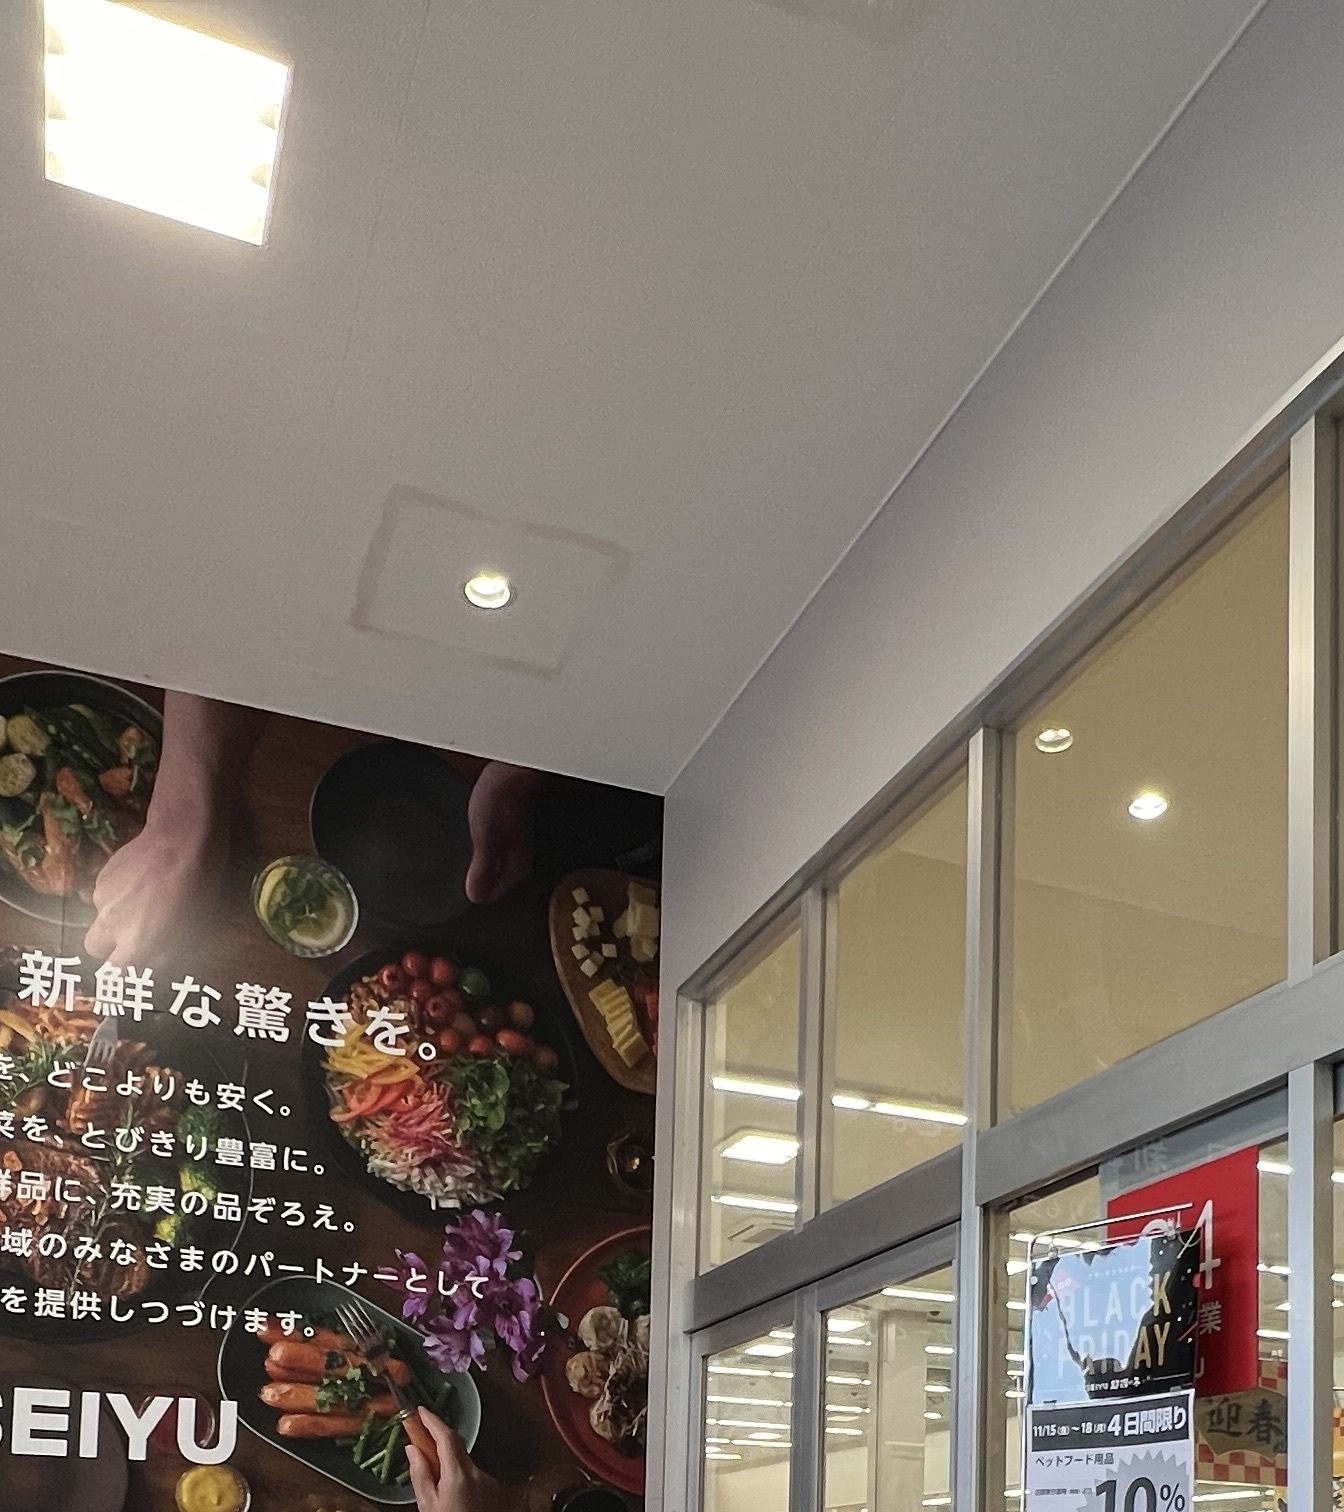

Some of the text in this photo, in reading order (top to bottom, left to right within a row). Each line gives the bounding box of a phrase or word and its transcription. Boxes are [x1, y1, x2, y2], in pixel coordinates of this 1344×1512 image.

[1059, 1270, 1172, 1331] BLACK
[1057, 1321, 1172, 1378] FRIDAY
[1205, 1396, 1285, 1445] 迎春
[1035, 1452, 1115, 1468] ペットフード用品
